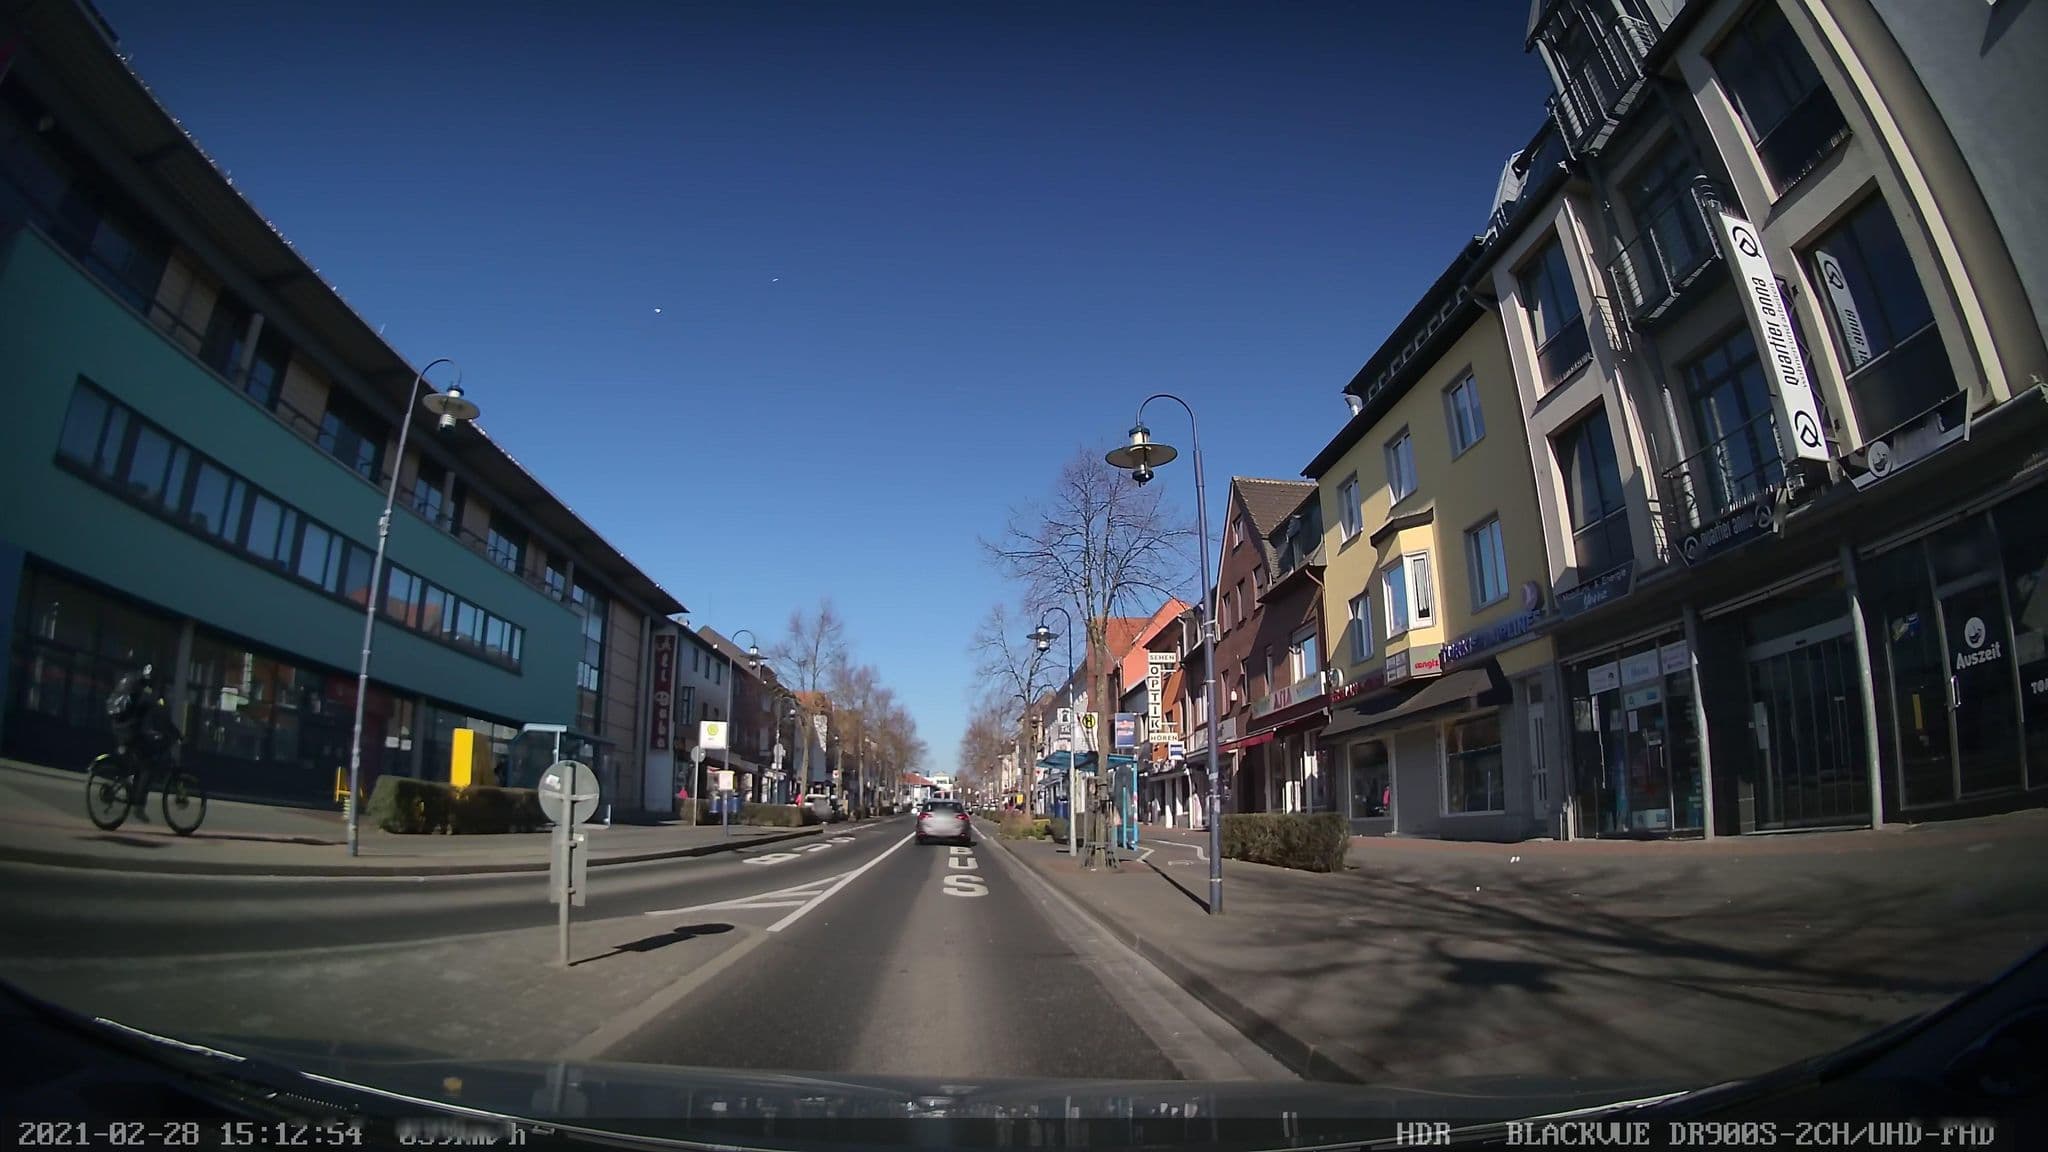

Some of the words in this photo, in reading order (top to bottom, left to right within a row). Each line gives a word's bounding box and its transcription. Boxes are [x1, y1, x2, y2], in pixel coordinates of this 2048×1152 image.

[1752, 276, 1776, 320] anna
[1767, 320, 1799, 386] quartier
[1956, 641, 2001, 670] Auszeit
[1150, 666, 1160, 729] OPTIK
